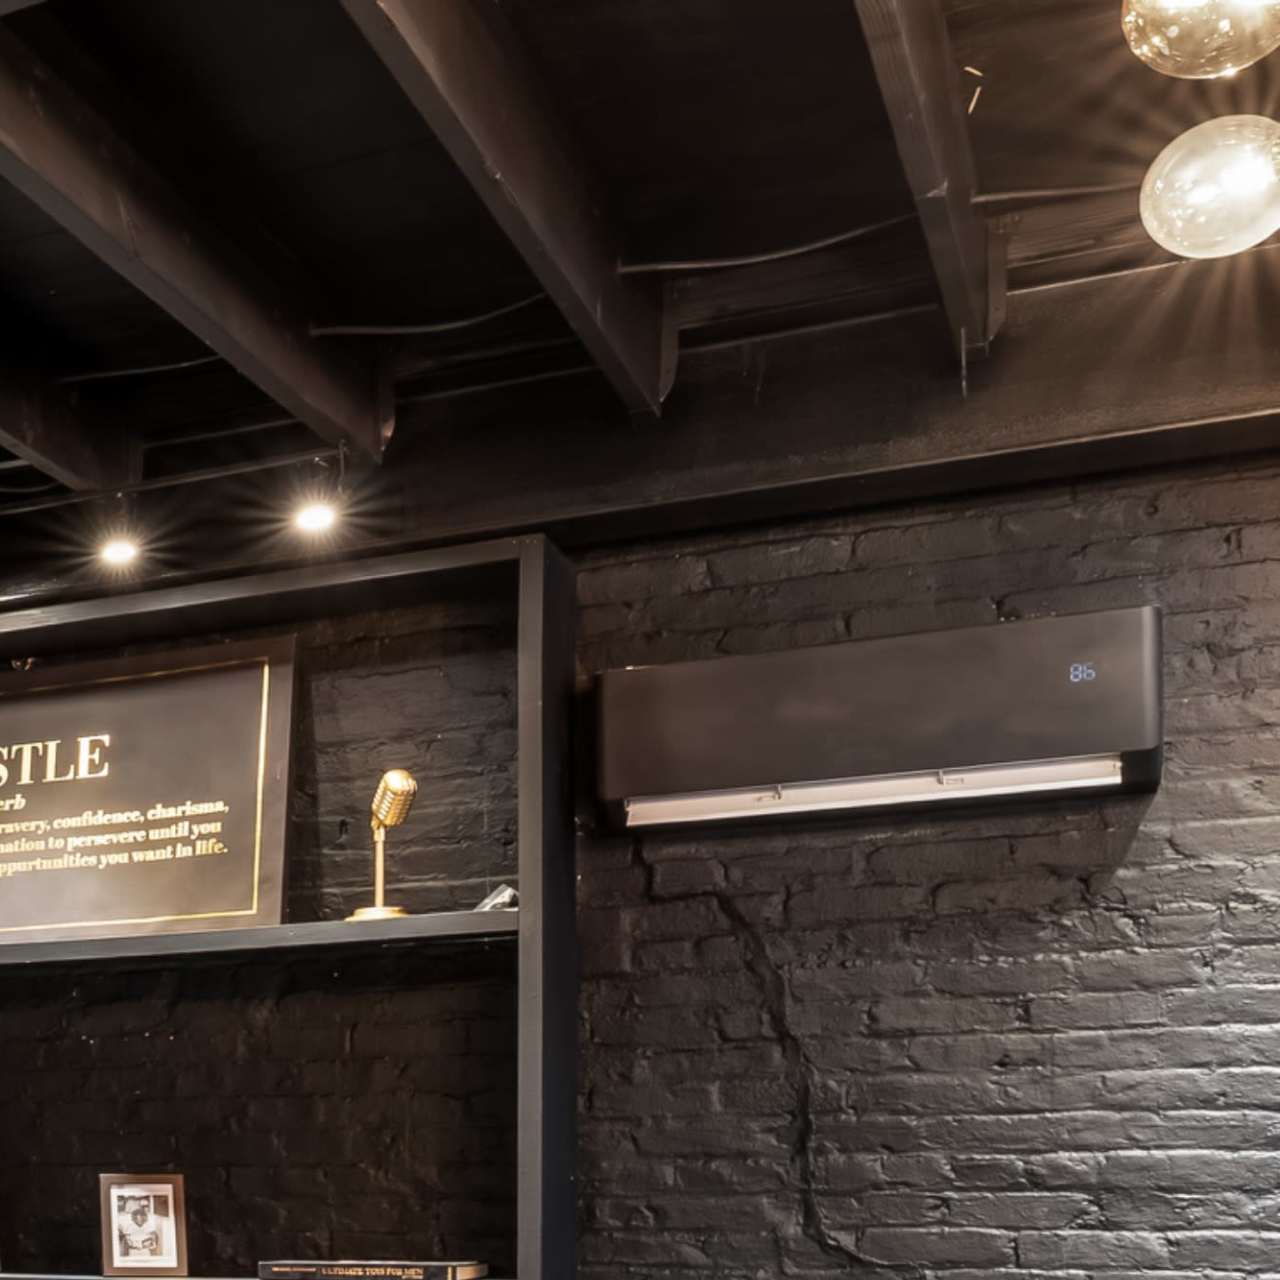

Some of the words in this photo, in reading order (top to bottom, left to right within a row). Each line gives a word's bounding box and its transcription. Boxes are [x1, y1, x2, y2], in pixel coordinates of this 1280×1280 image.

[52, 809, 145, 829] confidence,
[147, 800, 229, 820] charisma,
[47, 836, 65, 849] to
[67, 829, 146, 852] persevere
[148, 820, 189, 841] until
[190, 821, 222, 840] you
[98, 851, 129, 870] you
[131, 845, 174, 863] want
[175, 842, 193, 858] in
[195, 838, 228, 855] life.
